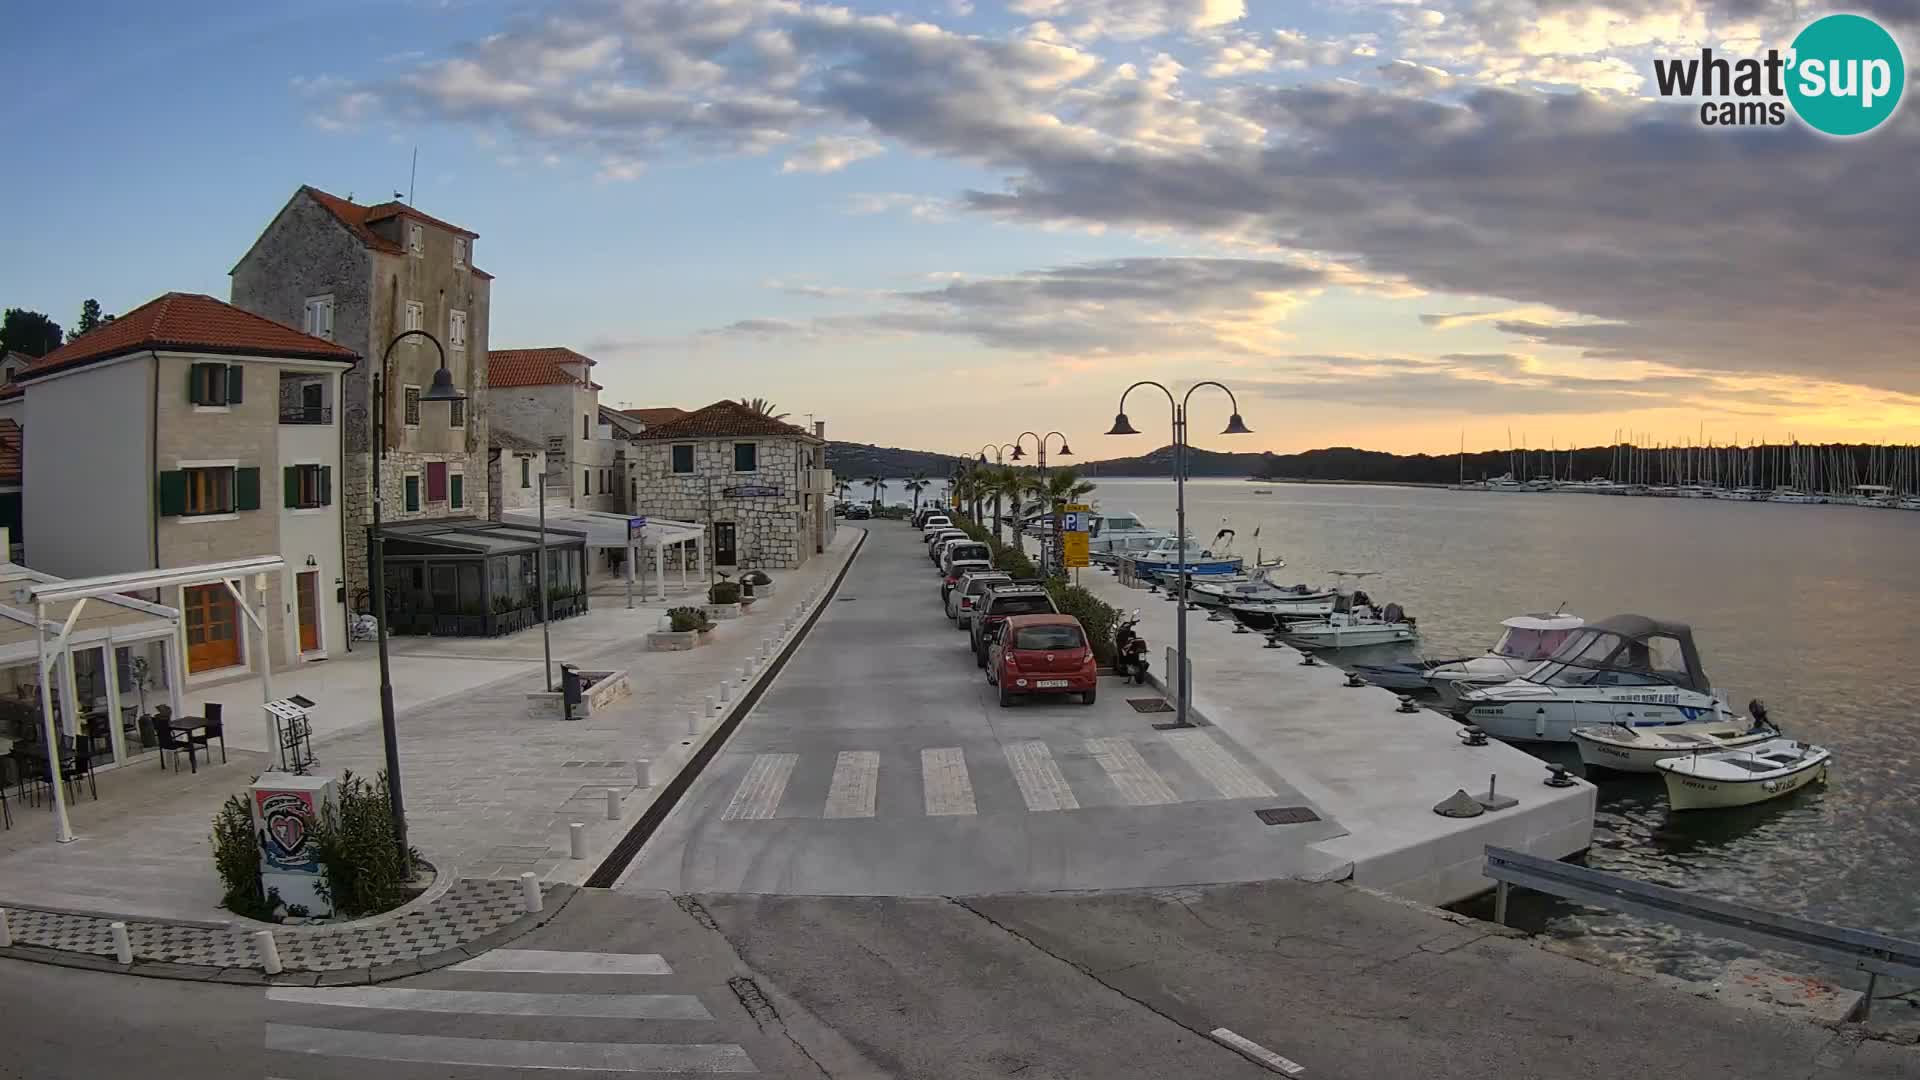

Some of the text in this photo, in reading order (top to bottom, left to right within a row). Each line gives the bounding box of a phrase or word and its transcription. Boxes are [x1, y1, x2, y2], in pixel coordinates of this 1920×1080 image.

[1066, 514, 1076, 529] P
[1641, 694, 1658, 703] RENT
[1664, 694, 1680, 704] BOAT
